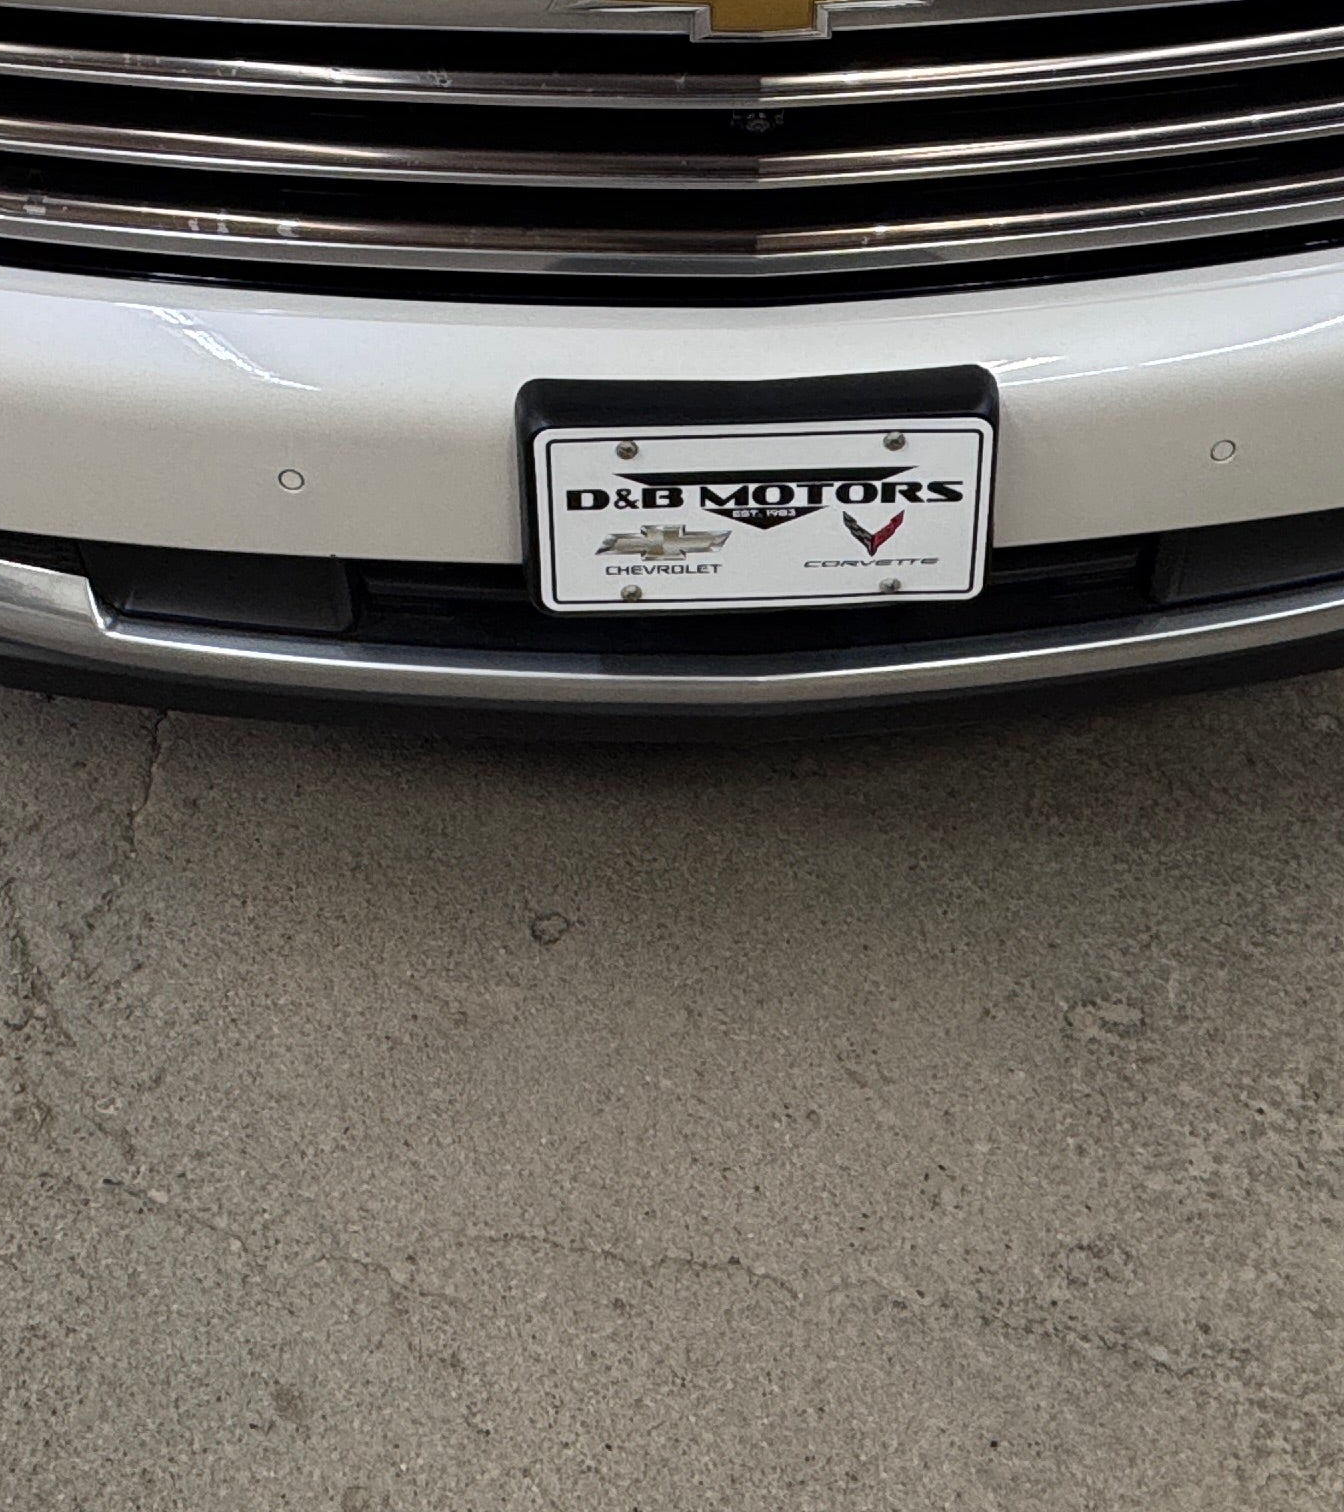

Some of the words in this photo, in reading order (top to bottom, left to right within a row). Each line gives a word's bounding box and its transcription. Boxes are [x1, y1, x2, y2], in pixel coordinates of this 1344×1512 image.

[566, 486, 685, 511] D&B
[699, 481, 964, 507] MOTORS
[803, 557, 940, 568] CORVETTE
[604, 563, 723, 576] CHEVROLET
